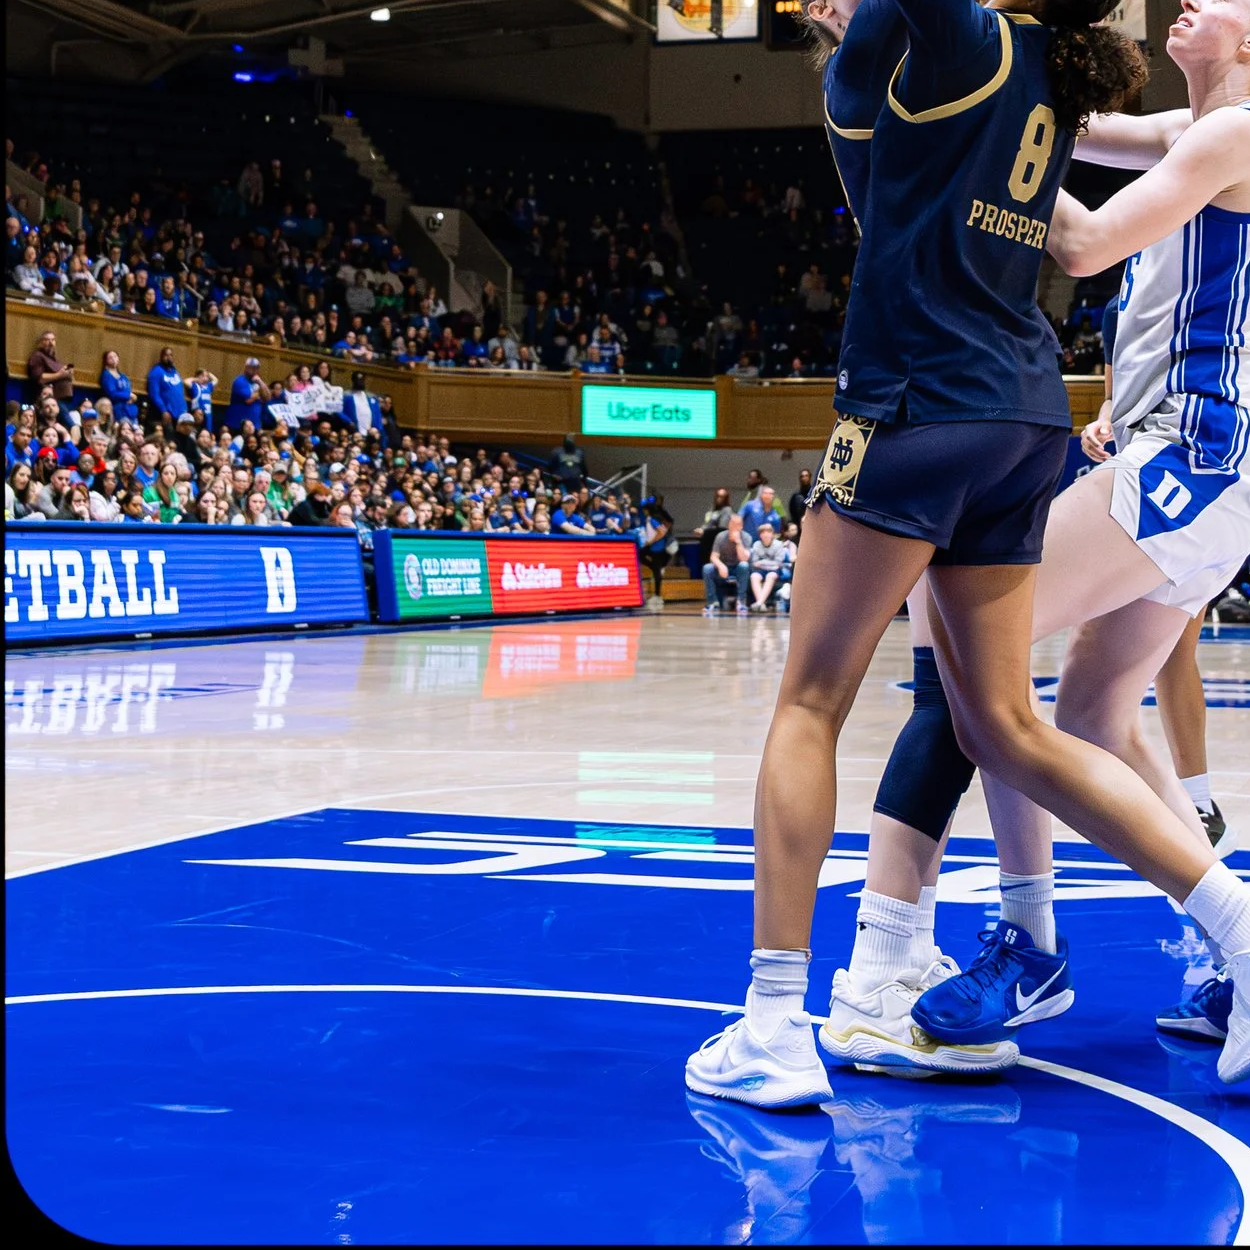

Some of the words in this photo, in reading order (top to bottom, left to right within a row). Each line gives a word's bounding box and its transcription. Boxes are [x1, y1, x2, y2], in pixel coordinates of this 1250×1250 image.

[1008, 103, 1056, 203] 8
[966, 199, 1047, 250] PROSPER
[422, 558, 439, 575] OLD
[441, 558, 481, 575] DOMINION
[463, 578, 482, 594] LINE
